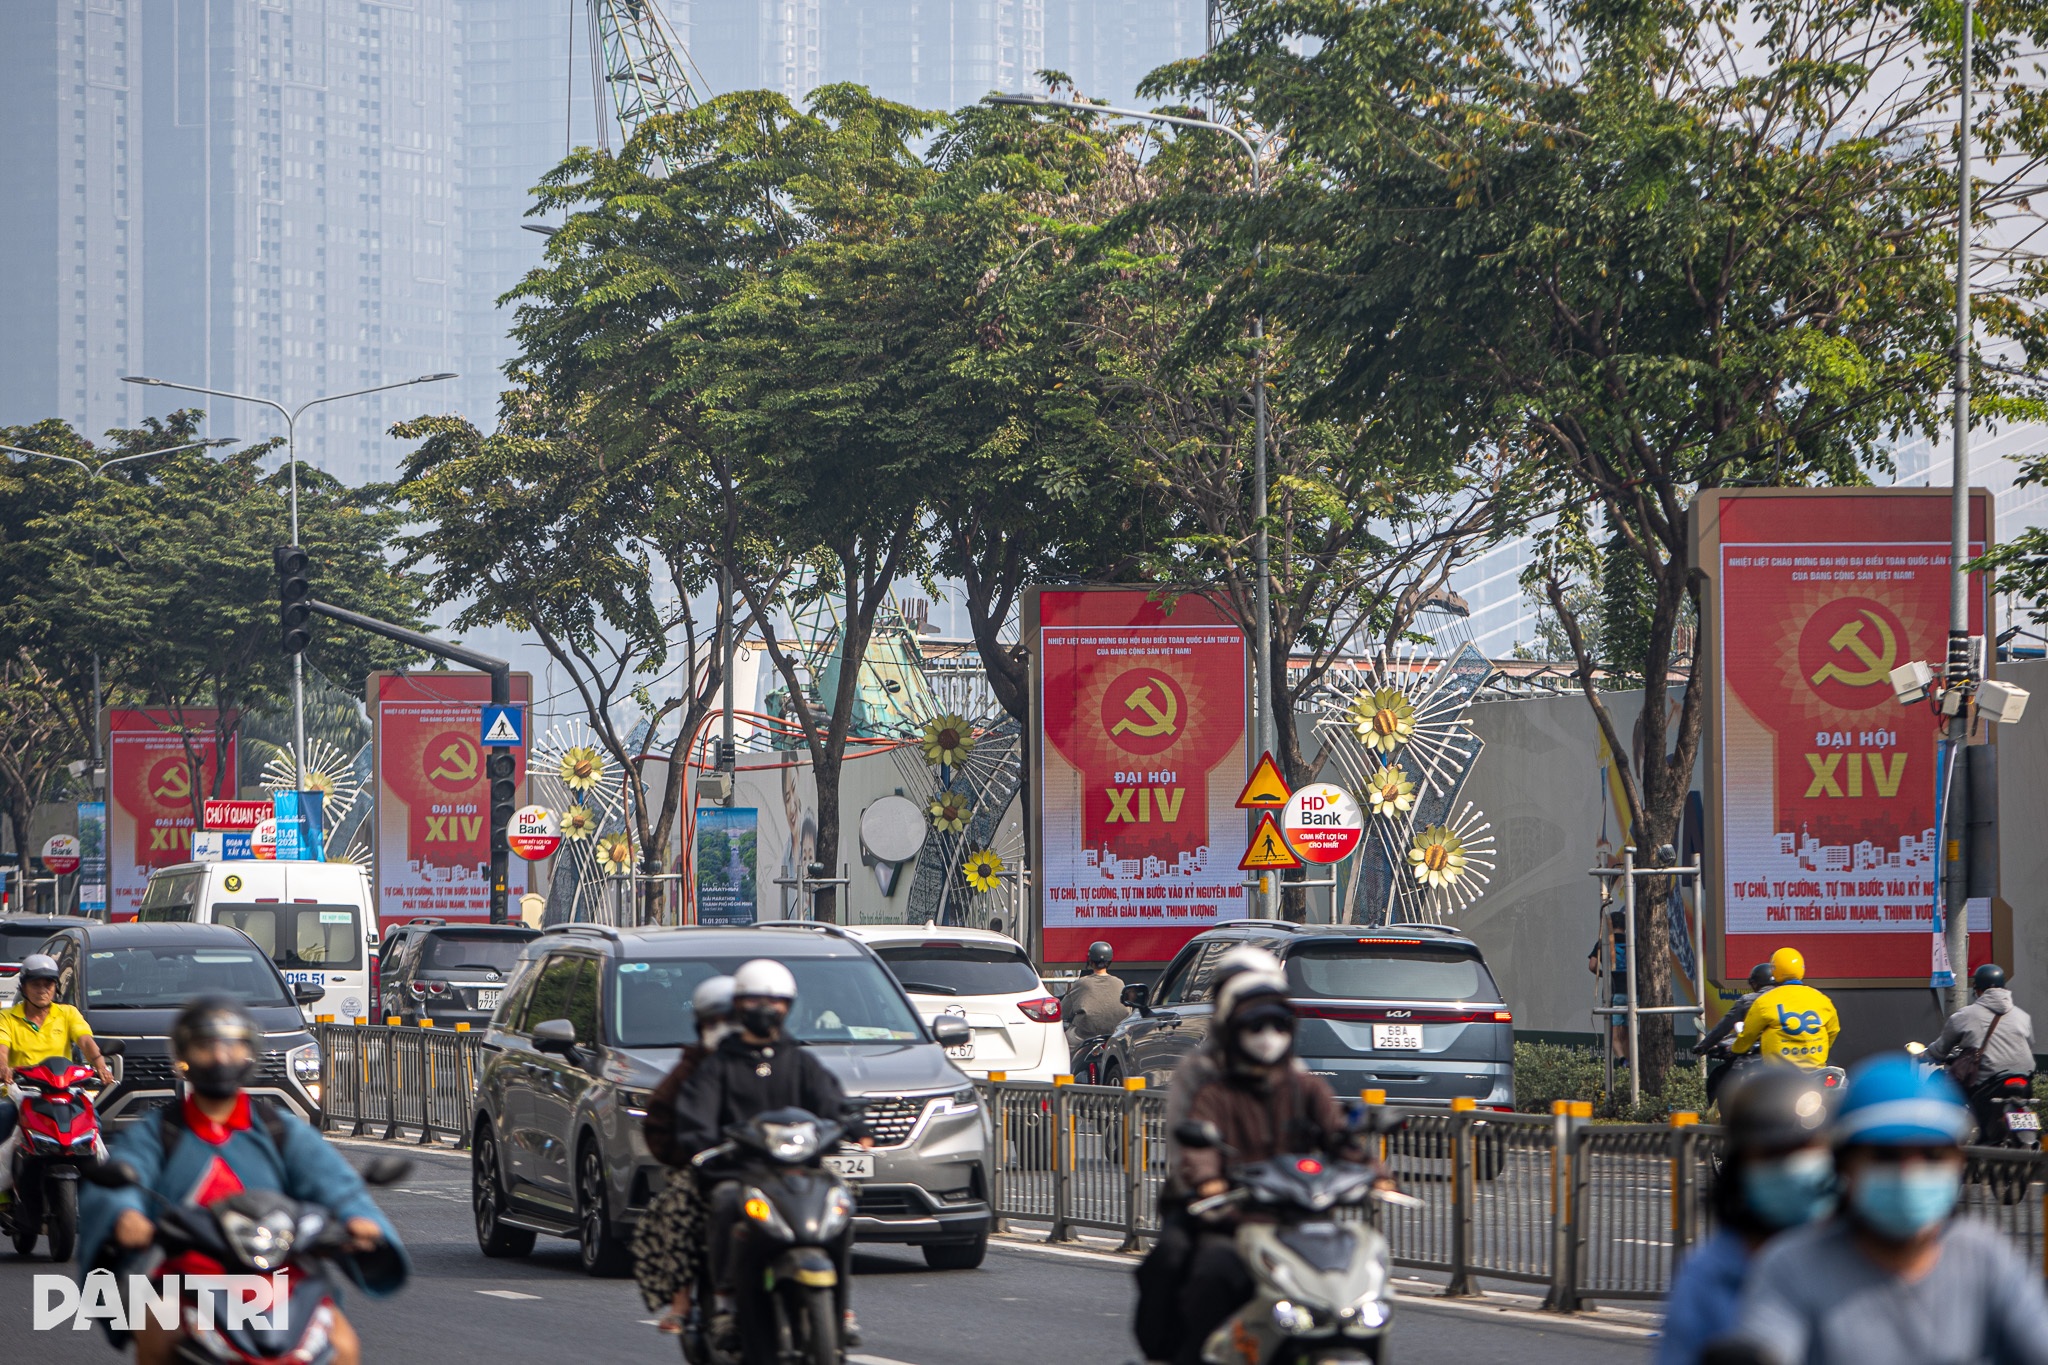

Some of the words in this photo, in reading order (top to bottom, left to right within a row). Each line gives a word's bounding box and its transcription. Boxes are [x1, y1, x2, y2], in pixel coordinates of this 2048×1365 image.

[1815, 731, 1852, 750] ĐẠI
[1860, 728, 1896, 750] HỘI
[1114, 771, 1142, 786] ĐẠI
[1148, 768, 1177, 786] HỘI
[1803, 752, 1908, 798] XIV
[431, 804, 452, 816] ĐẠI
[456, 802, 478, 816] HỘI
[1105, 787, 1186, 823] XIV
[1301, 796, 1325, 811] HD
[205, 803, 224, 824] CHÚ
[224, 803, 231, 824] Ý
[231, 807, 253, 824] QUAN
[254, 803, 273, 825] SÁT
[519, 814, 536, 824] HD
[1301, 811, 1342, 826] Bank
[277, 829, 298, 838] 11.01
[424, 815, 484, 842] XIV
[519, 824, 547, 834] Bank
[1315, 831, 1326, 840] KẾT
[1326, 832, 1337, 841] LỢI
[1337, 832, 1348, 840] ÍCH
[1323, 840, 1340, 849] NHẤT
[1050, 886, 1060, 902] TỰ
[1061, 882, 1078, 900] CHỦ,
[1080, 886, 1091, 902] TỰ
[1091, 885, 1119, 900] CƯỜNG,
[1121, 886, 1131, 901] TỰ
[1132, 886, 1145, 899] TIN
[1146, 884, 1166, 899] BƯỚC
[1168, 884, 1183, 899] VÀO
[1185, 881, 1195, 898] KỶ
[1196, 883, 1226, 898] NGUYÊN
[1228, 884, 1243, 898] MỚI
[1734, 881, 1746, 898] TỰ
[1748, 876, 1770, 898] CHỦ,
[1773, 881, 1786, 898] TỰ
[1788, 878, 1823, 898] CƯỜNG,
[1826, 881, 1839, 898] TỰ
[1840, 882, 1855, 897] TIN
[1858, 879, 1884, 897] BƯỚC
[1886, 879, 1904, 897] VÀO
[1908, 875, 1920, 896] KỶ
[1075, 903, 1095, 918] PHÁT
[1097, 900, 1118, 918] TRIỂN
[1120, 902, 1138, 918] GIÀU
[1139, 905, 1164, 920] MẠNH,
[1166, 905, 1188, 920] THỊNH
[1189, 903, 1218, 919] VƯỢNG!
[1767, 904, 1791, 921] PHÁT
[1793, 900, 1822, 921] TRIỂN
[1824, 903, 1847, 920] GIÀU
[1850, 905, 1881, 923] MẠNH,
[1884, 905, 1912, 923] THỊNH
[1777, 1003, 1822, 1035] be
[1388, 1026, 1408, 1036] 68A
[1380, 1037, 1417, 1048] 259.96
